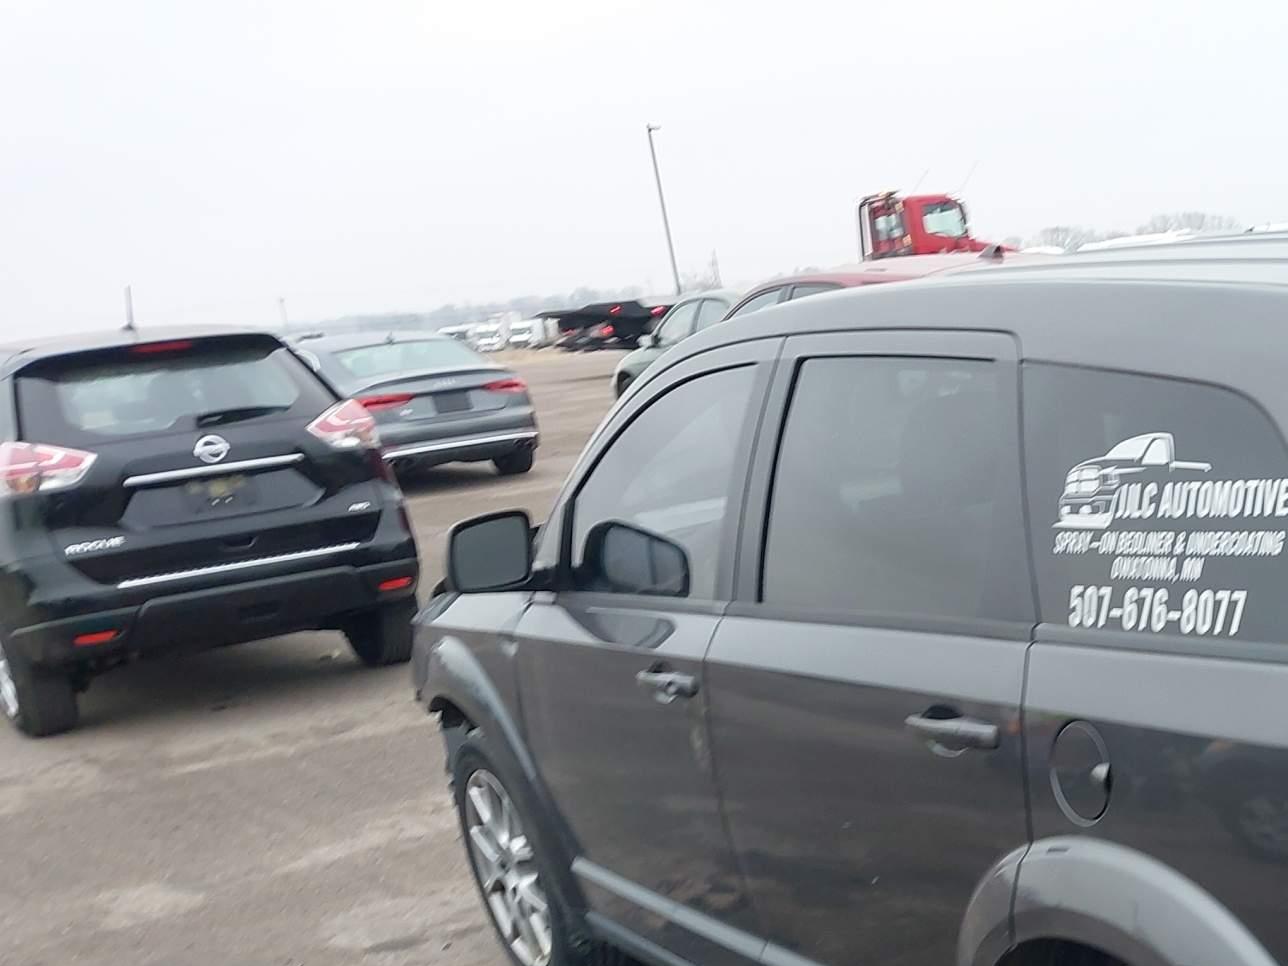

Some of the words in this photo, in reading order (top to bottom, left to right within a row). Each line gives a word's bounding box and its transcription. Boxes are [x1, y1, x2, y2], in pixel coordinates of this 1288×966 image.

[64, 535, 126, 556] ROGUE
[1115, 531, 1176, 555] BEDLINER
[1185, 530, 1286, 556] UNDERCOATING
[1068, 584, 1248, 636] 507-676-8077
